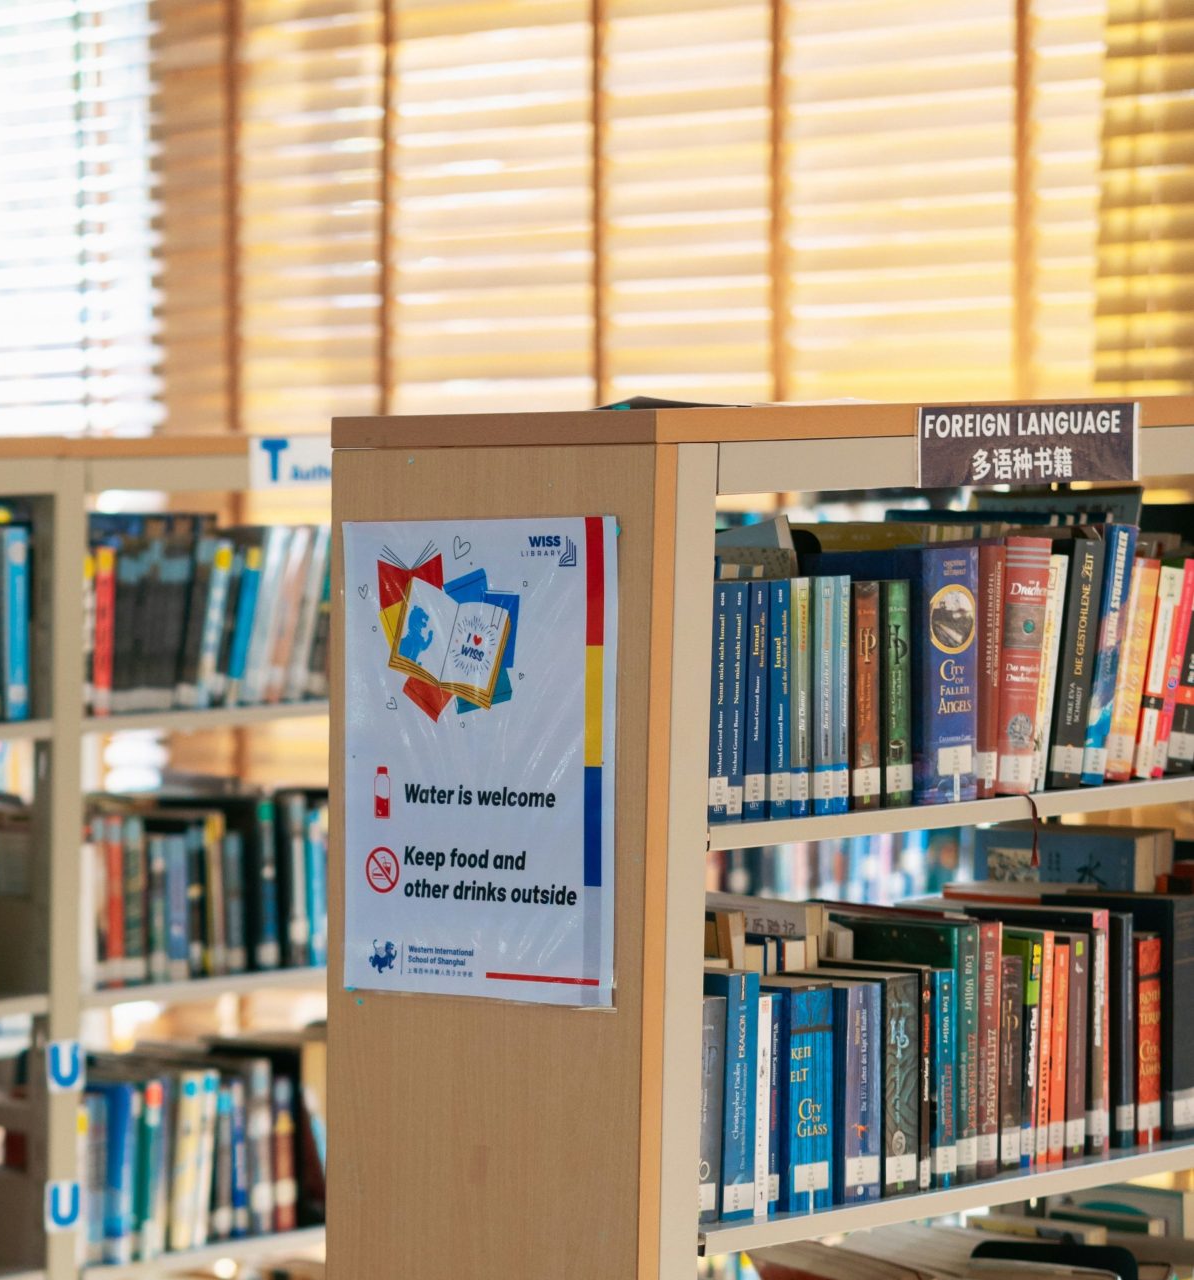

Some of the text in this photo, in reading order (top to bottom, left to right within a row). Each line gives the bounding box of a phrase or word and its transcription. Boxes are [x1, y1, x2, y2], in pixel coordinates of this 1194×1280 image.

[924, 410, 1121, 438] FOREIGN LANGUAGE
[260, 438, 289, 482] T
[972, 446, 1073, 481] 多语种书籍
[520, 550, 561, 558] LIBRARY
[528, 536, 561, 548] WISS
[735, 613, 743, 640] Ismael!
[985, 573, 995, 675] ANDREAS STEINHÖFEL
[1073, 552, 1095, 676] DIE GESTOHLENE ZEIT
[466, 632, 472, 643] I
[752, 624, 760, 656] Ismael
[461, 645, 485, 663] WISS
[773, 637, 782, 668] Ismael
[939, 659, 965, 682] CITY
[717, 683, 725, 705] Nennt
[940, 685, 970, 697] FALLEN
[1065, 682, 1076, 726] HEIKE EVA
[1073, 686, 1084, 723] SCHMIDT
[937, 698, 972, 715] ANGELS
[404, 783, 556, 808] Water is welcome
[404, 846, 526, 872] Keep food and
[404, 878, 577, 907] other drinks outside
[408, 944, 474, 957] Western International
[408, 955, 429, 964] School
[437, 957, 466, 967] Shanghai
[942, 995, 950, 1014] Eva
[1029, 1007, 1038, 1029] Chat
[737, 1015, 746, 1058] ERAGON
[772, 1022, 780, 1056] Wladimir
[942, 1016, 951, 1044] Völler
[964, 954, 977, 1131] Eva Völler ZEITENZAUBER
[984, 951, 997, 1125] Eva Völler ZEITENZAUBER
[49, 1043, 79, 1088] U
[771, 1056, 779, 1086] Kaminer
[732, 1062, 741, 1140] Christopher Paolini
[798, 1098, 822, 1121] CITY
[796, 1120, 828, 1138] GLASS
[50, 1183, 80, 1227] U
